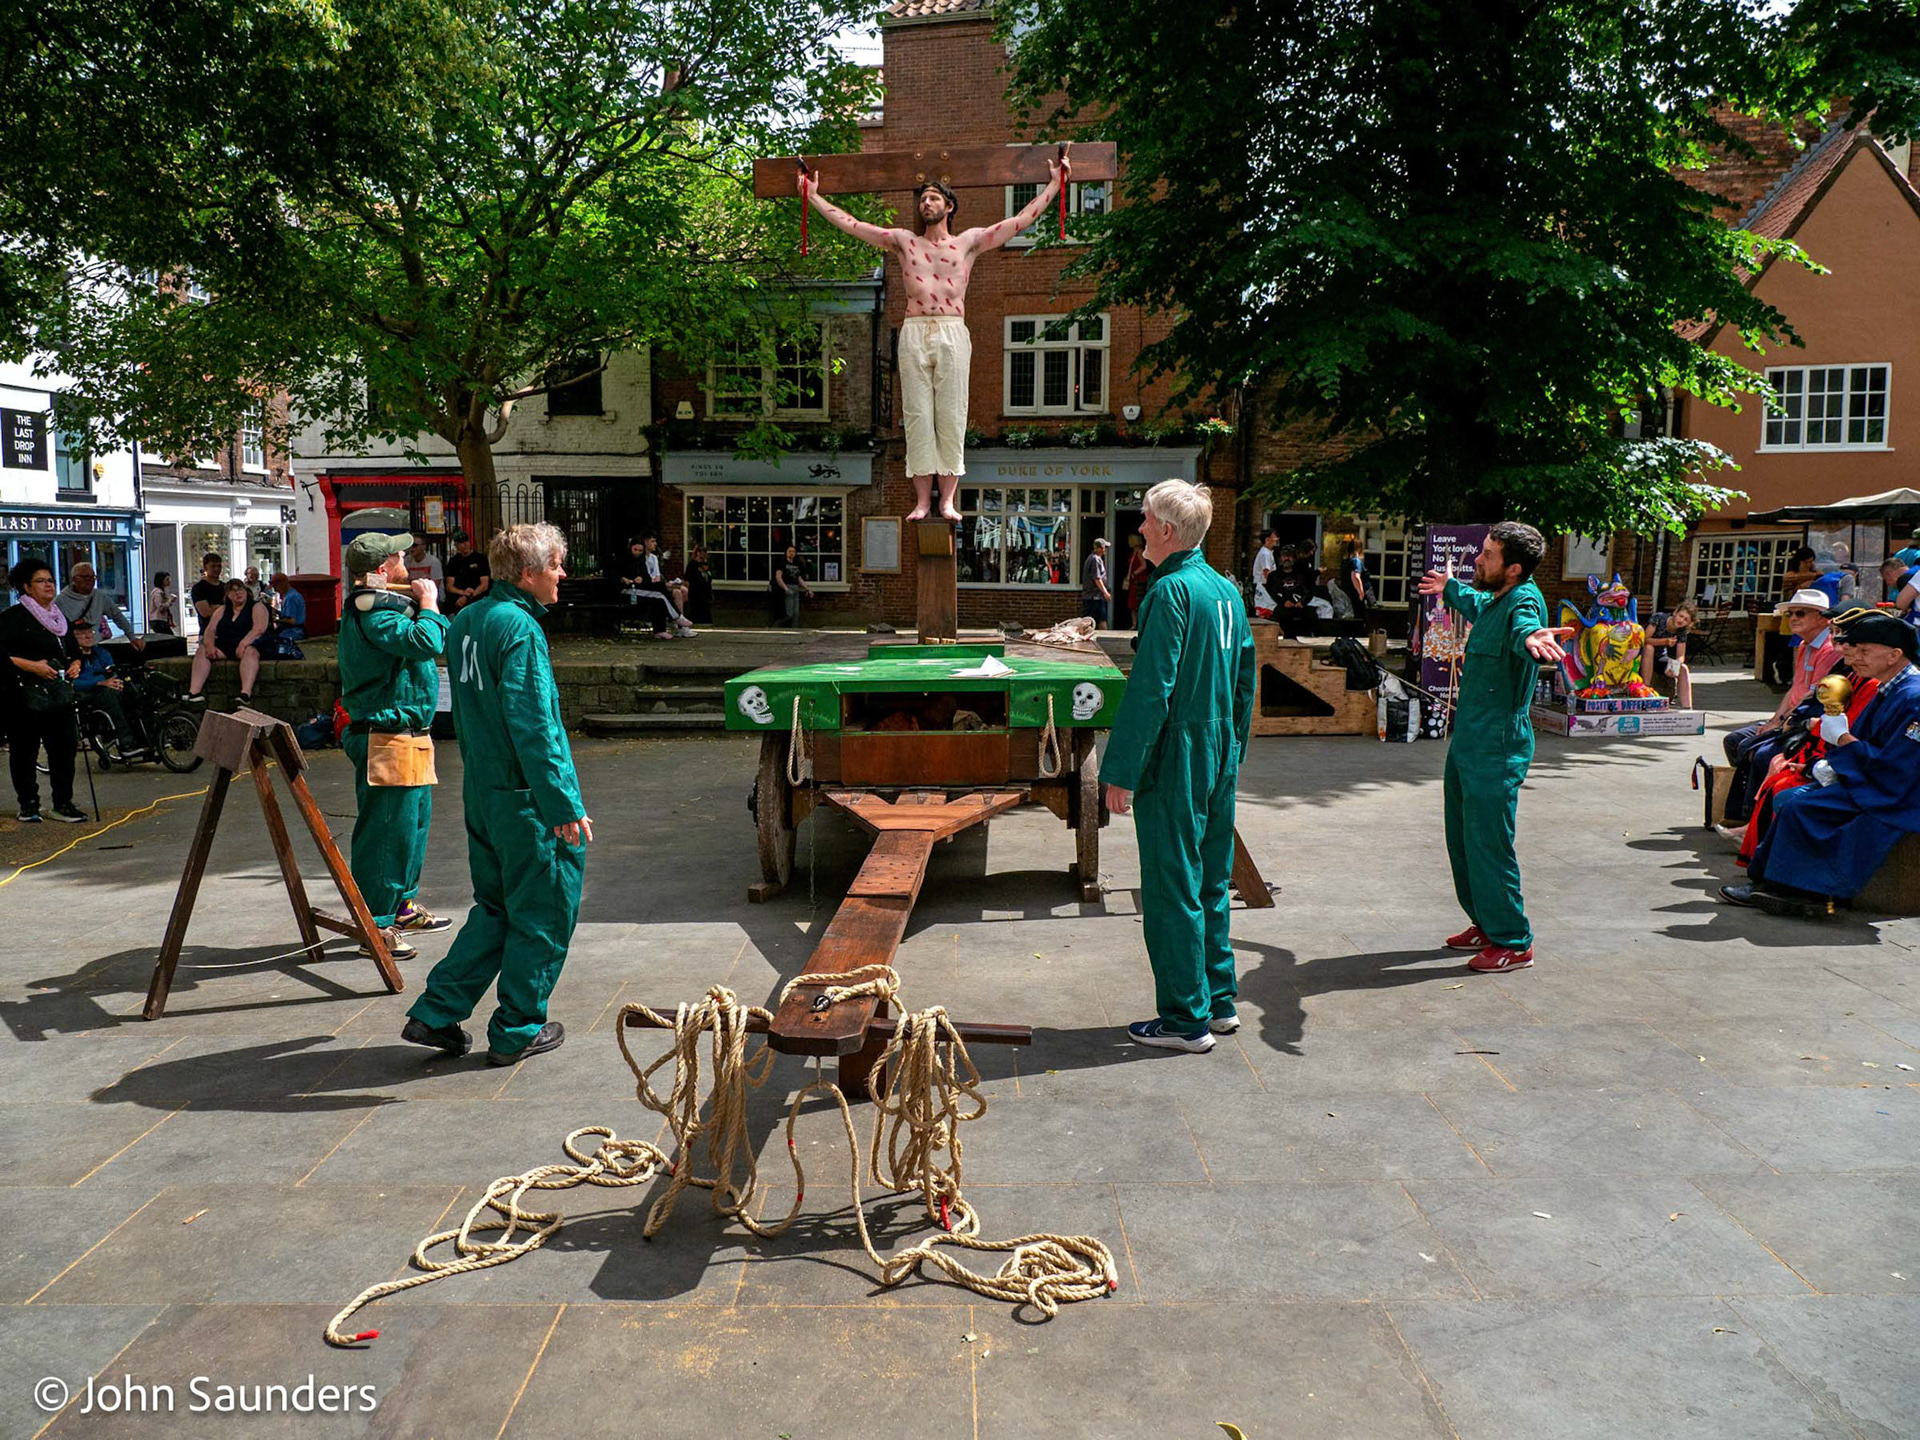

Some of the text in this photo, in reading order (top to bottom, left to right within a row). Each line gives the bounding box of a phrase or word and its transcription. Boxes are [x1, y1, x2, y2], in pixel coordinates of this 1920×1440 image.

[15, 414, 32, 426] THE
[14, 427, 34, 439] LAST
[14, 440, 35, 451] DROP
[18, 453, 33, 464] INN
[998, 465, 1111, 476] DUKE OF YORK
[0, 516, 112, 531] LAST DROP INN
[1433, 534, 1457, 543] Leave
[1432, 554, 1445, 562] No
[1433, 564, 1448, 572] Jus
